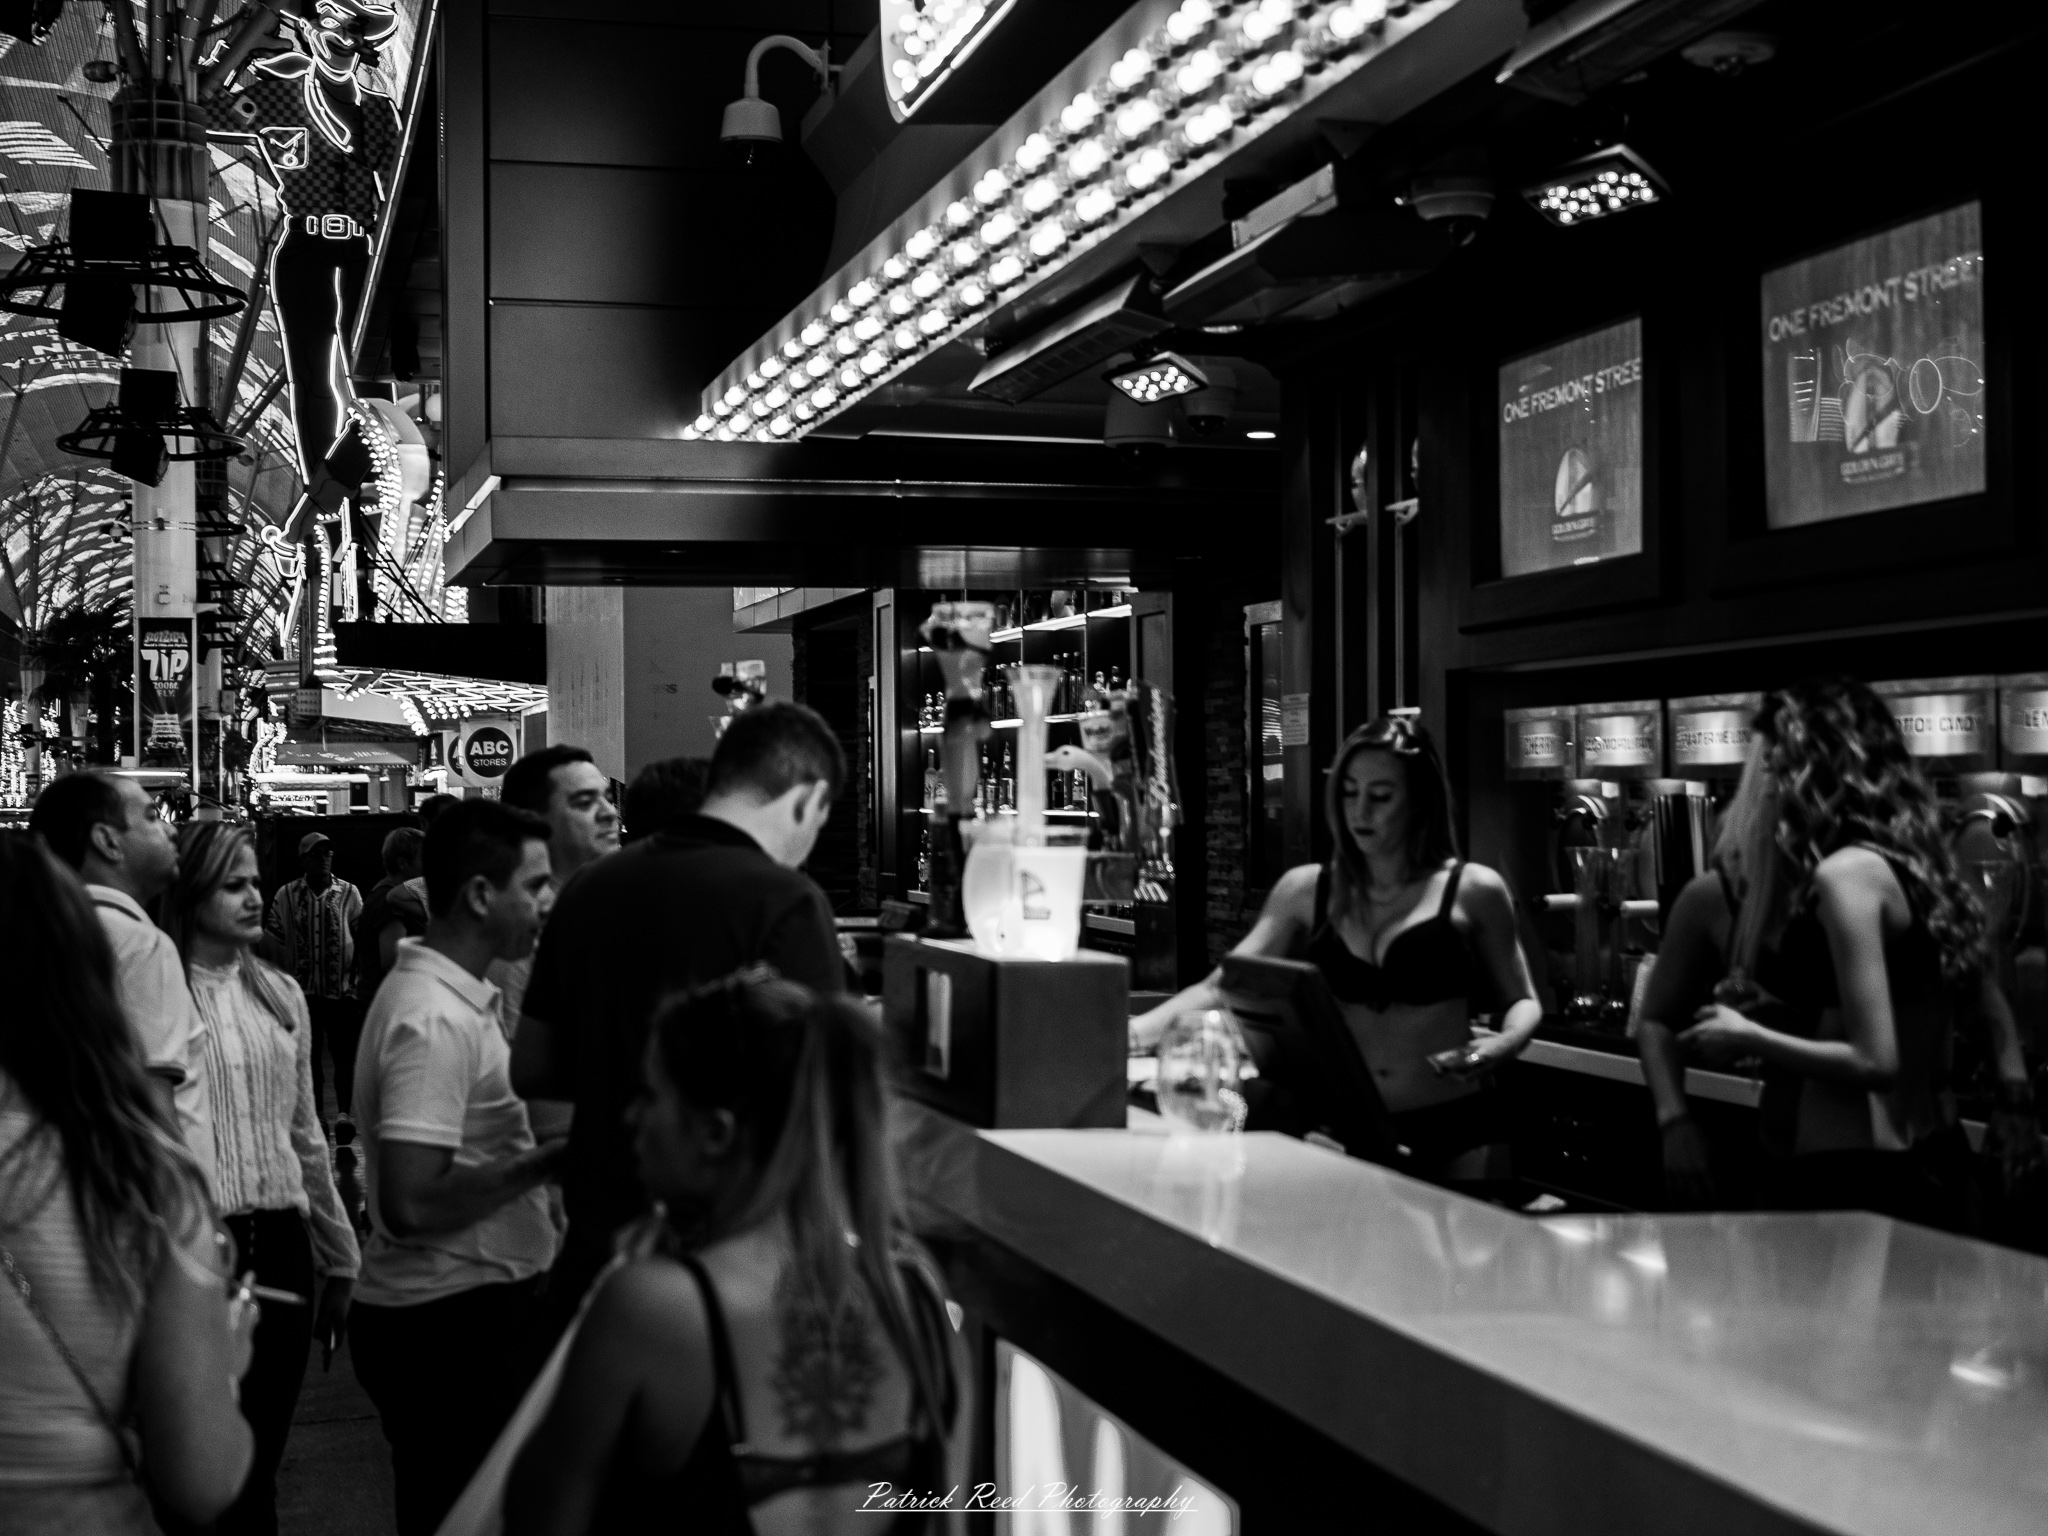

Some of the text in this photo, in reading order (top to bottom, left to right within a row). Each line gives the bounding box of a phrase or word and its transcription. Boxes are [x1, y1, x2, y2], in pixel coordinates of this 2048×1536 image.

[1768, 308, 1806, 342] ONE
[1808, 276, 1901, 329] FREMONT
[1503, 396, 1530, 424] ONE
[1531, 373, 1594, 415] FREMONT
[469, 740, 509, 755] ABC
[473, 757, 507, 767] STORES
